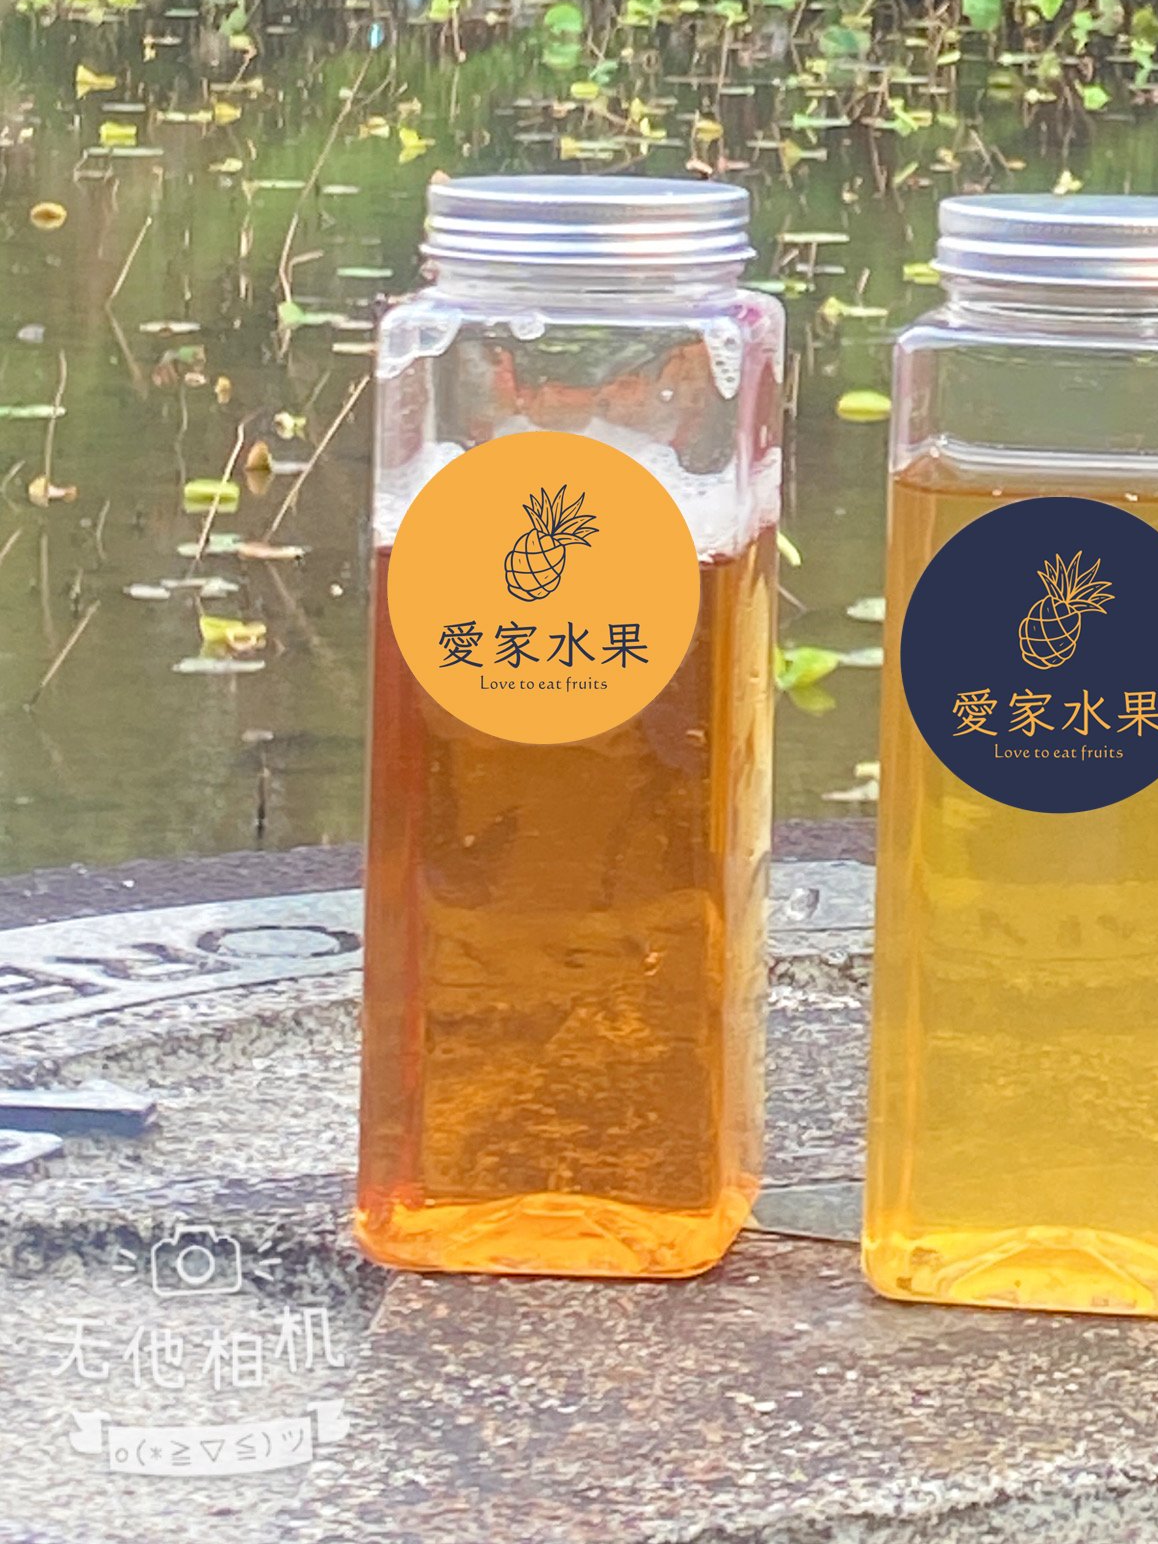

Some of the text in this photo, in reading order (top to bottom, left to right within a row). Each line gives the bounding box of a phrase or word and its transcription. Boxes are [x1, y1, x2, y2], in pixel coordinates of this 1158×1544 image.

[438, 620, 649, 669] 愛家水果
[480, 675, 608, 692] Love to eat fruits
[994, 743, 1124, 761] Love to eat fruits
